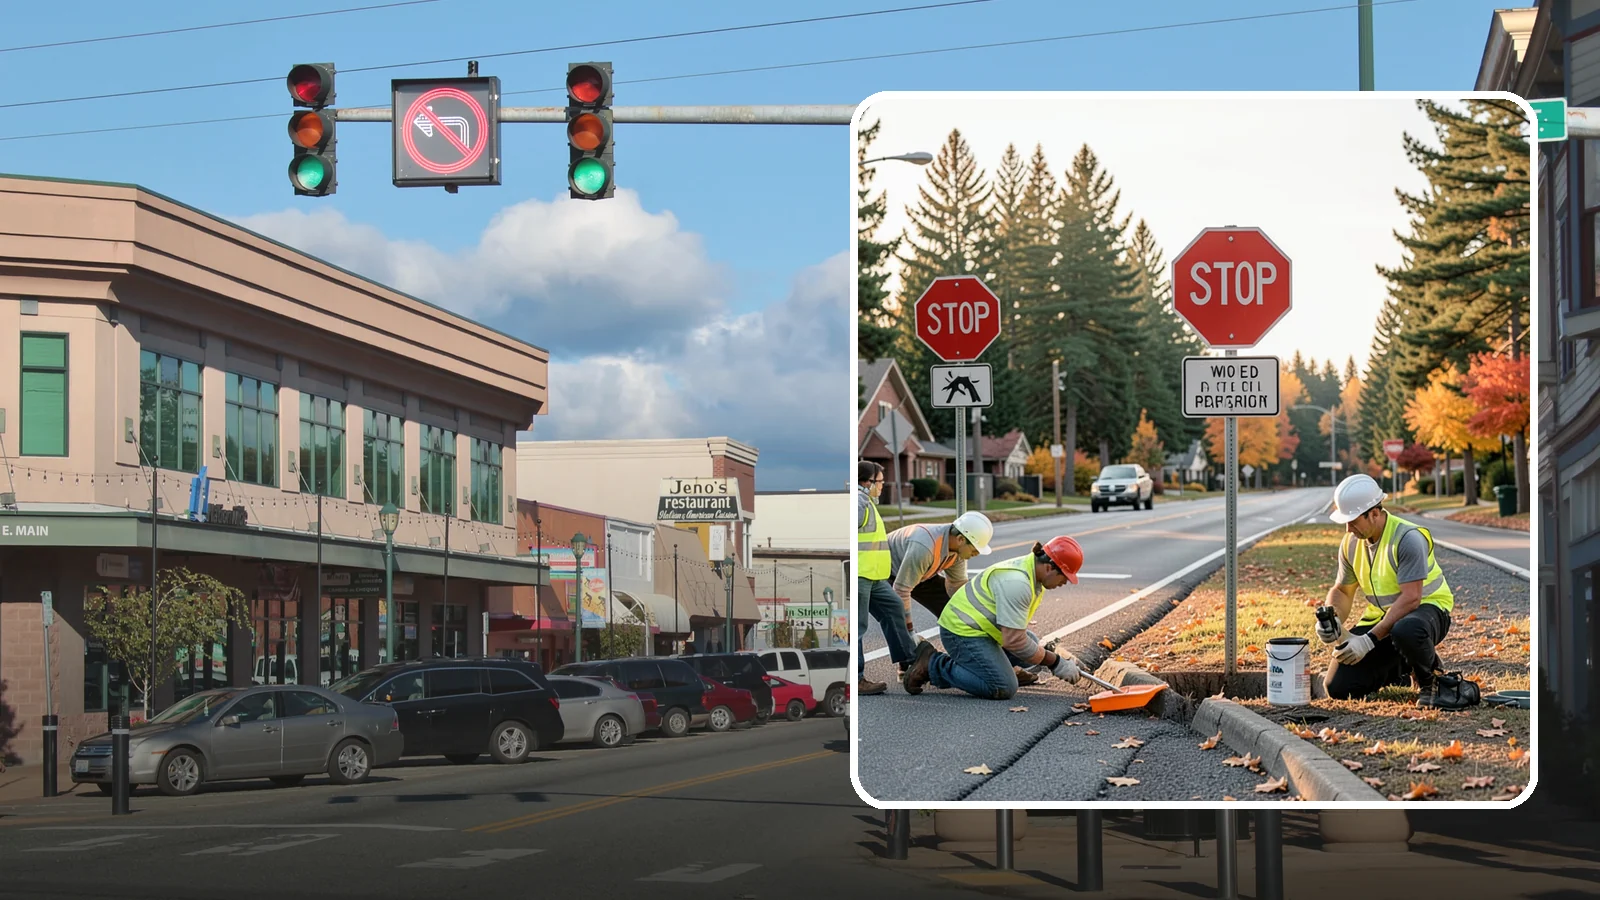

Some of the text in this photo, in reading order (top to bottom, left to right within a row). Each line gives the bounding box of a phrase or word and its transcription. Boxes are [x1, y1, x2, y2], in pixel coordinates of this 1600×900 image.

[1189, 260, 1278, 306] STOP
[927, 301, 990, 335] STOP
[669, 479, 728, 495] Jeno's
[665, 496, 731, 509] restaurant
[658, 509, 682, 520] Italian
[685, 509, 714, 520] American
[714, 509, 737, 520] Cuisine
[2, 525, 49, 536] E. MAIN
[797, 607, 829, 617] Street
